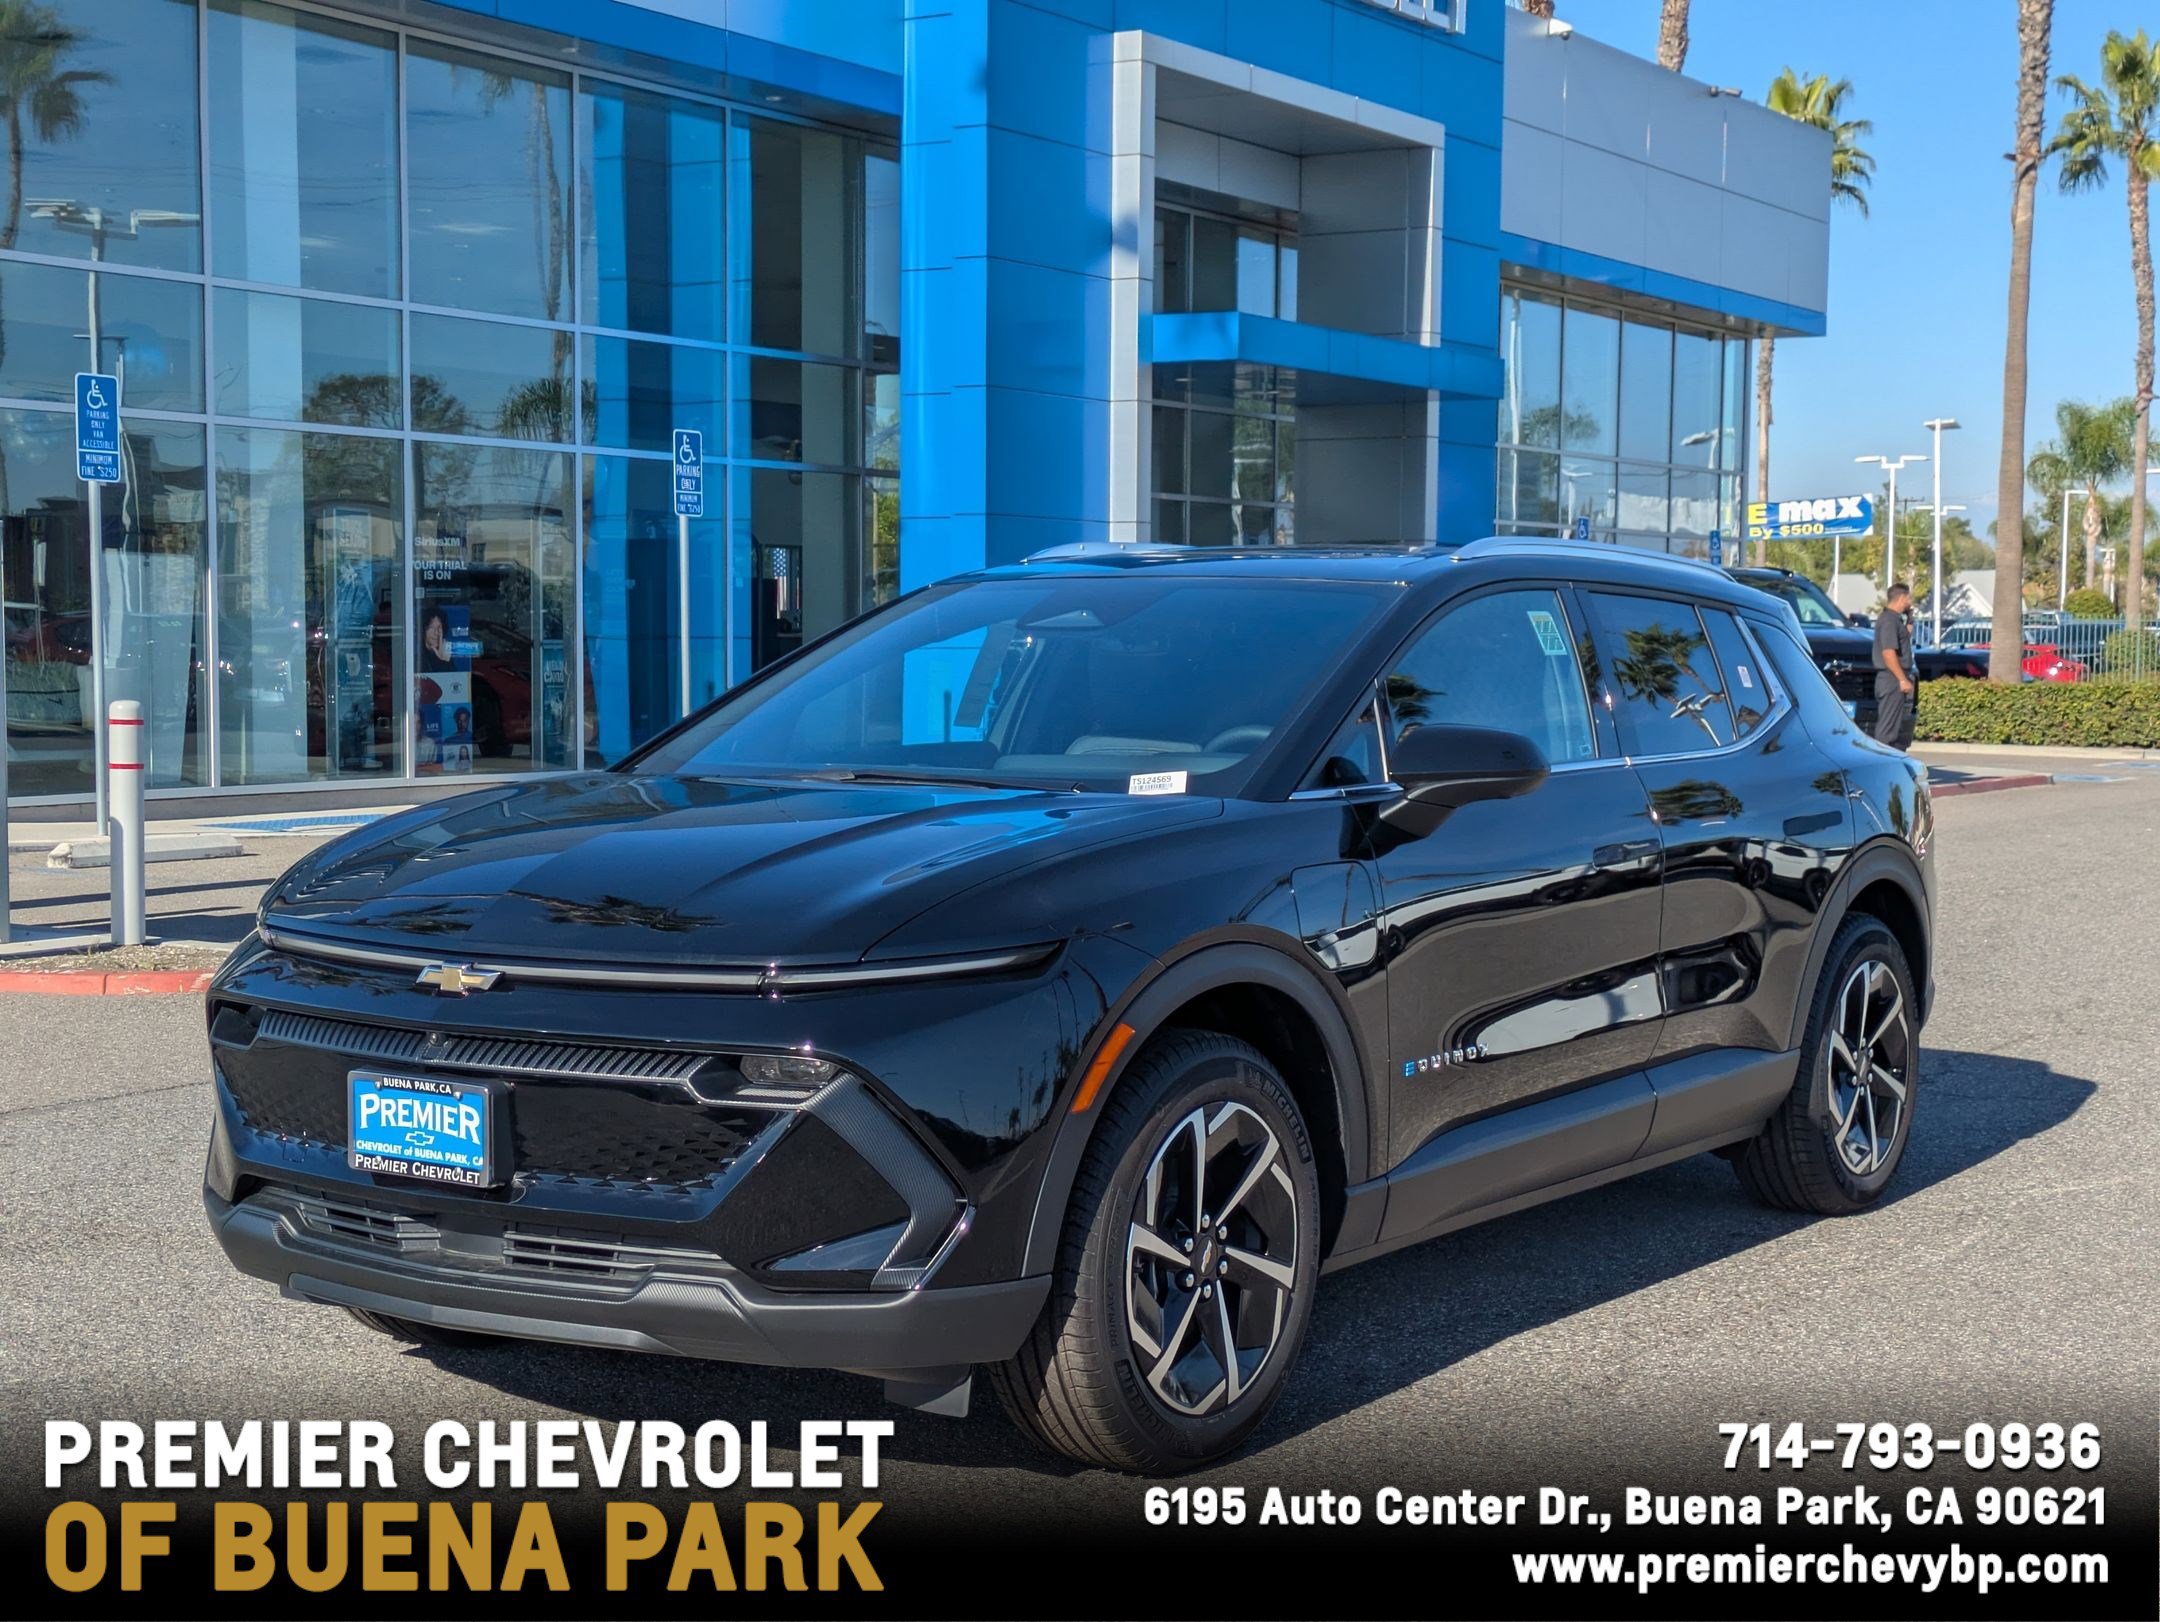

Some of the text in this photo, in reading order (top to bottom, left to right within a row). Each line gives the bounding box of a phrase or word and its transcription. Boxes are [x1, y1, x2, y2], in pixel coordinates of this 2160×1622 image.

[86, 410, 110, 420] PARKING
[91, 420, 105, 429] ONLY
[93, 430, 104, 438] VAN
[83, 439, 115, 450] ACCESSIBLE
[85, 453, 113, 465] MINIMUM
[81, 465, 95, 477] FINE
[676, 463, 701, 477] PARKING
[681, 478, 697, 490] ONLY
[1779, 496, 1864, 523] max
[1749, 526, 1774, 540] By
[1779, 523, 1825, 538] $500
[414, 536, 461, 547] SiriusXM
[437, 560, 468, 571] TRIAL
[423, 570, 452, 581] IS ON
[1132, 775, 1172, 786] TS124569
[383, 1077, 412, 1090] BUENA
[359, 1093, 481, 1145] PREMIER
[1262, 1079, 1310, 1159] MICHELIN
[356, 1139, 402, 1155] CHEVROLET
[404, 1145, 414, 1156] of
[415, 1148, 444, 1161] BUENA
[445, 1152, 471, 1167] PARK,
[355, 1154, 480, 1185] PREMIER CHEVROLET
